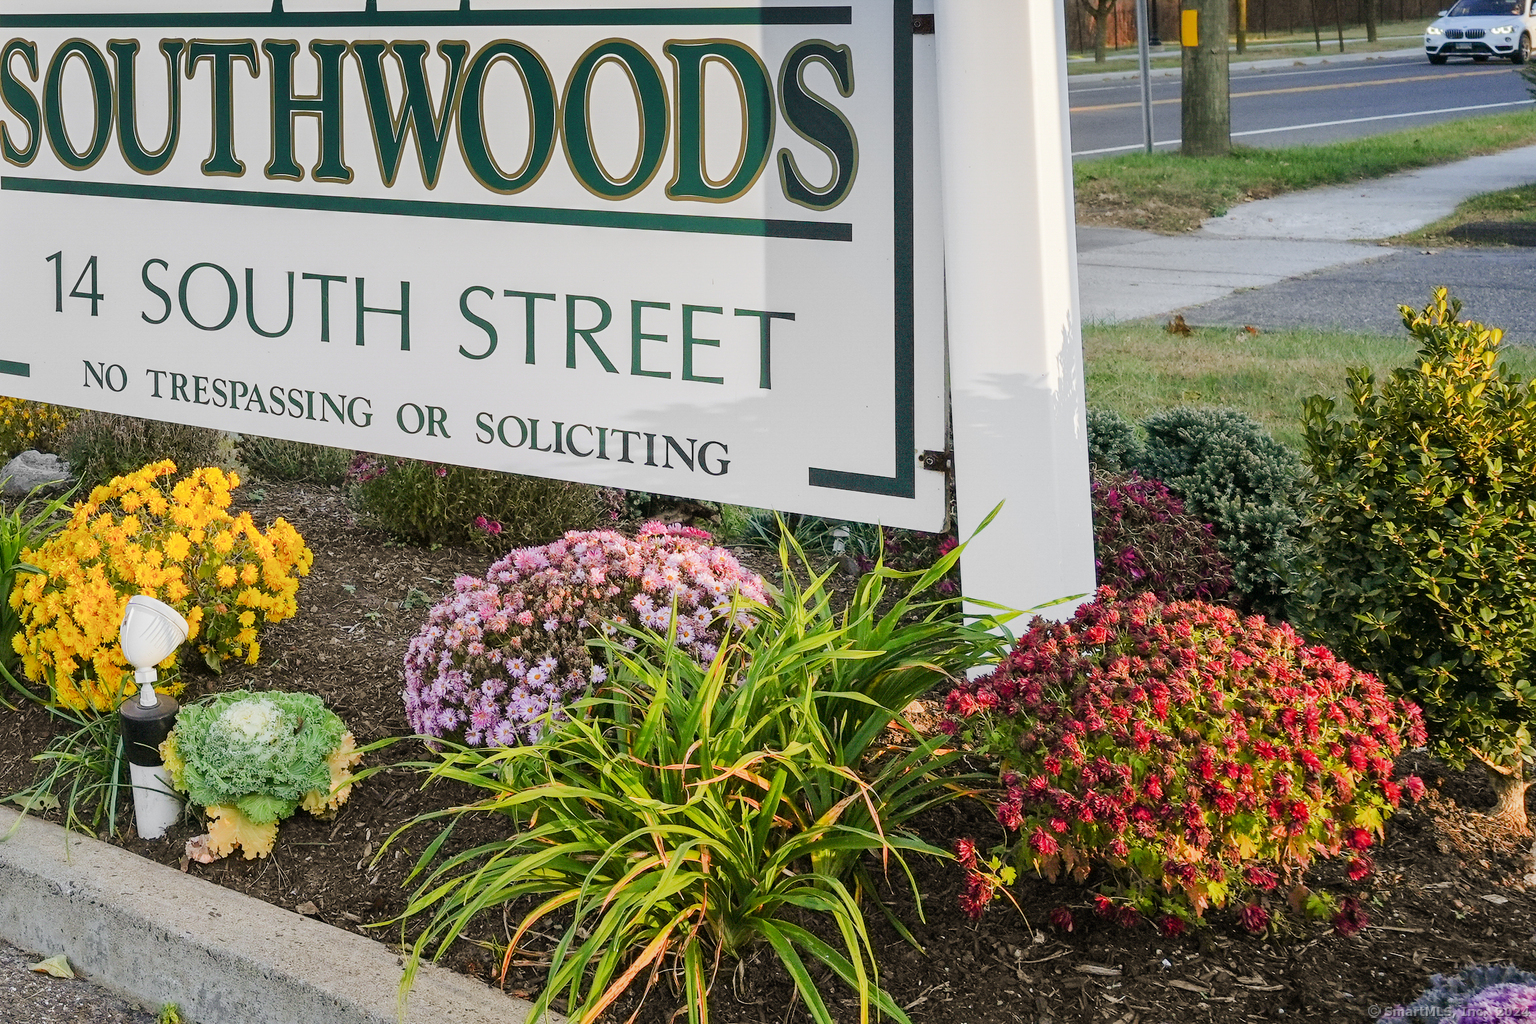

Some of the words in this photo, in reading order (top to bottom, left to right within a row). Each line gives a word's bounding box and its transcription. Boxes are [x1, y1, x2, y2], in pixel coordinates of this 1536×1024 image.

[45, 250, 105, 317] 14
[141, 258, 411, 352] SOUTH
[459, 285, 796, 390] STREET
[82, 359, 128, 393] NO
[145, 368, 374, 428] TRESPASSING
[396, 402, 452, 439] OR
[475, 411, 731, 476] SOLICITING
